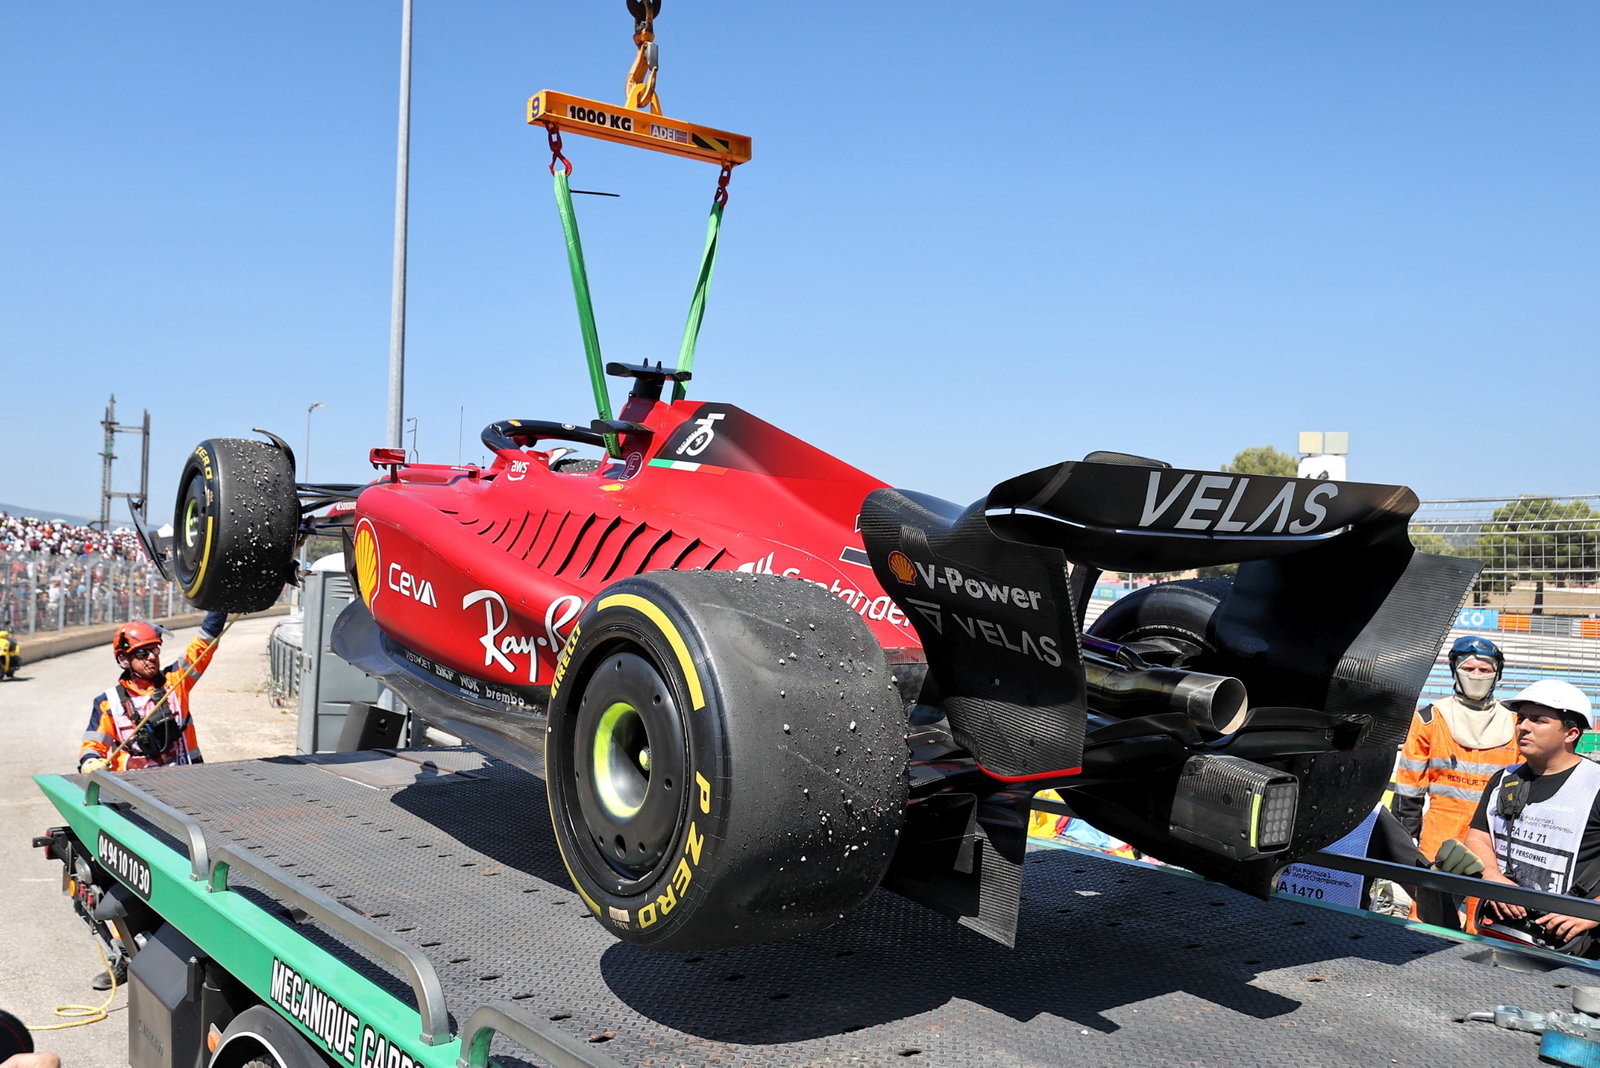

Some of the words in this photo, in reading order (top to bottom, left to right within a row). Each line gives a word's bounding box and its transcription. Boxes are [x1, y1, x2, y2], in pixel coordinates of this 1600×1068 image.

[532, 97, 540, 118] 9
[569, 105, 606, 126] 1000
[610, 114, 632, 132] KG
[511, 460, 530, 474] aws
[1138, 471, 1339, 534] VELAS
[914, 561, 1042, 611] V-Power
[952, 613, 1062, 668] VELAS
[551, 620, 581, 699] PIRELLI
[460, 675, 480, 693] NGK
[485, 686, 525, 706] brembo
[696, 771, 711, 815] P
[1447, 774, 1479, 786] RESCUE
[1536, 833, 1547, 844] 71
[99, 834, 108, 861] 04
[108, 842, 118, 869] 94
[119, 850, 128, 877] 10
[129, 858, 139, 885] 10
[139, 865, 150, 894] 30
[638, 821, 705, 929] ZERO
[1291, 883, 1324, 900] 1470
[270, 957, 360, 1065] MECANIQUE
[361, 1026, 425, 1068] CAR
